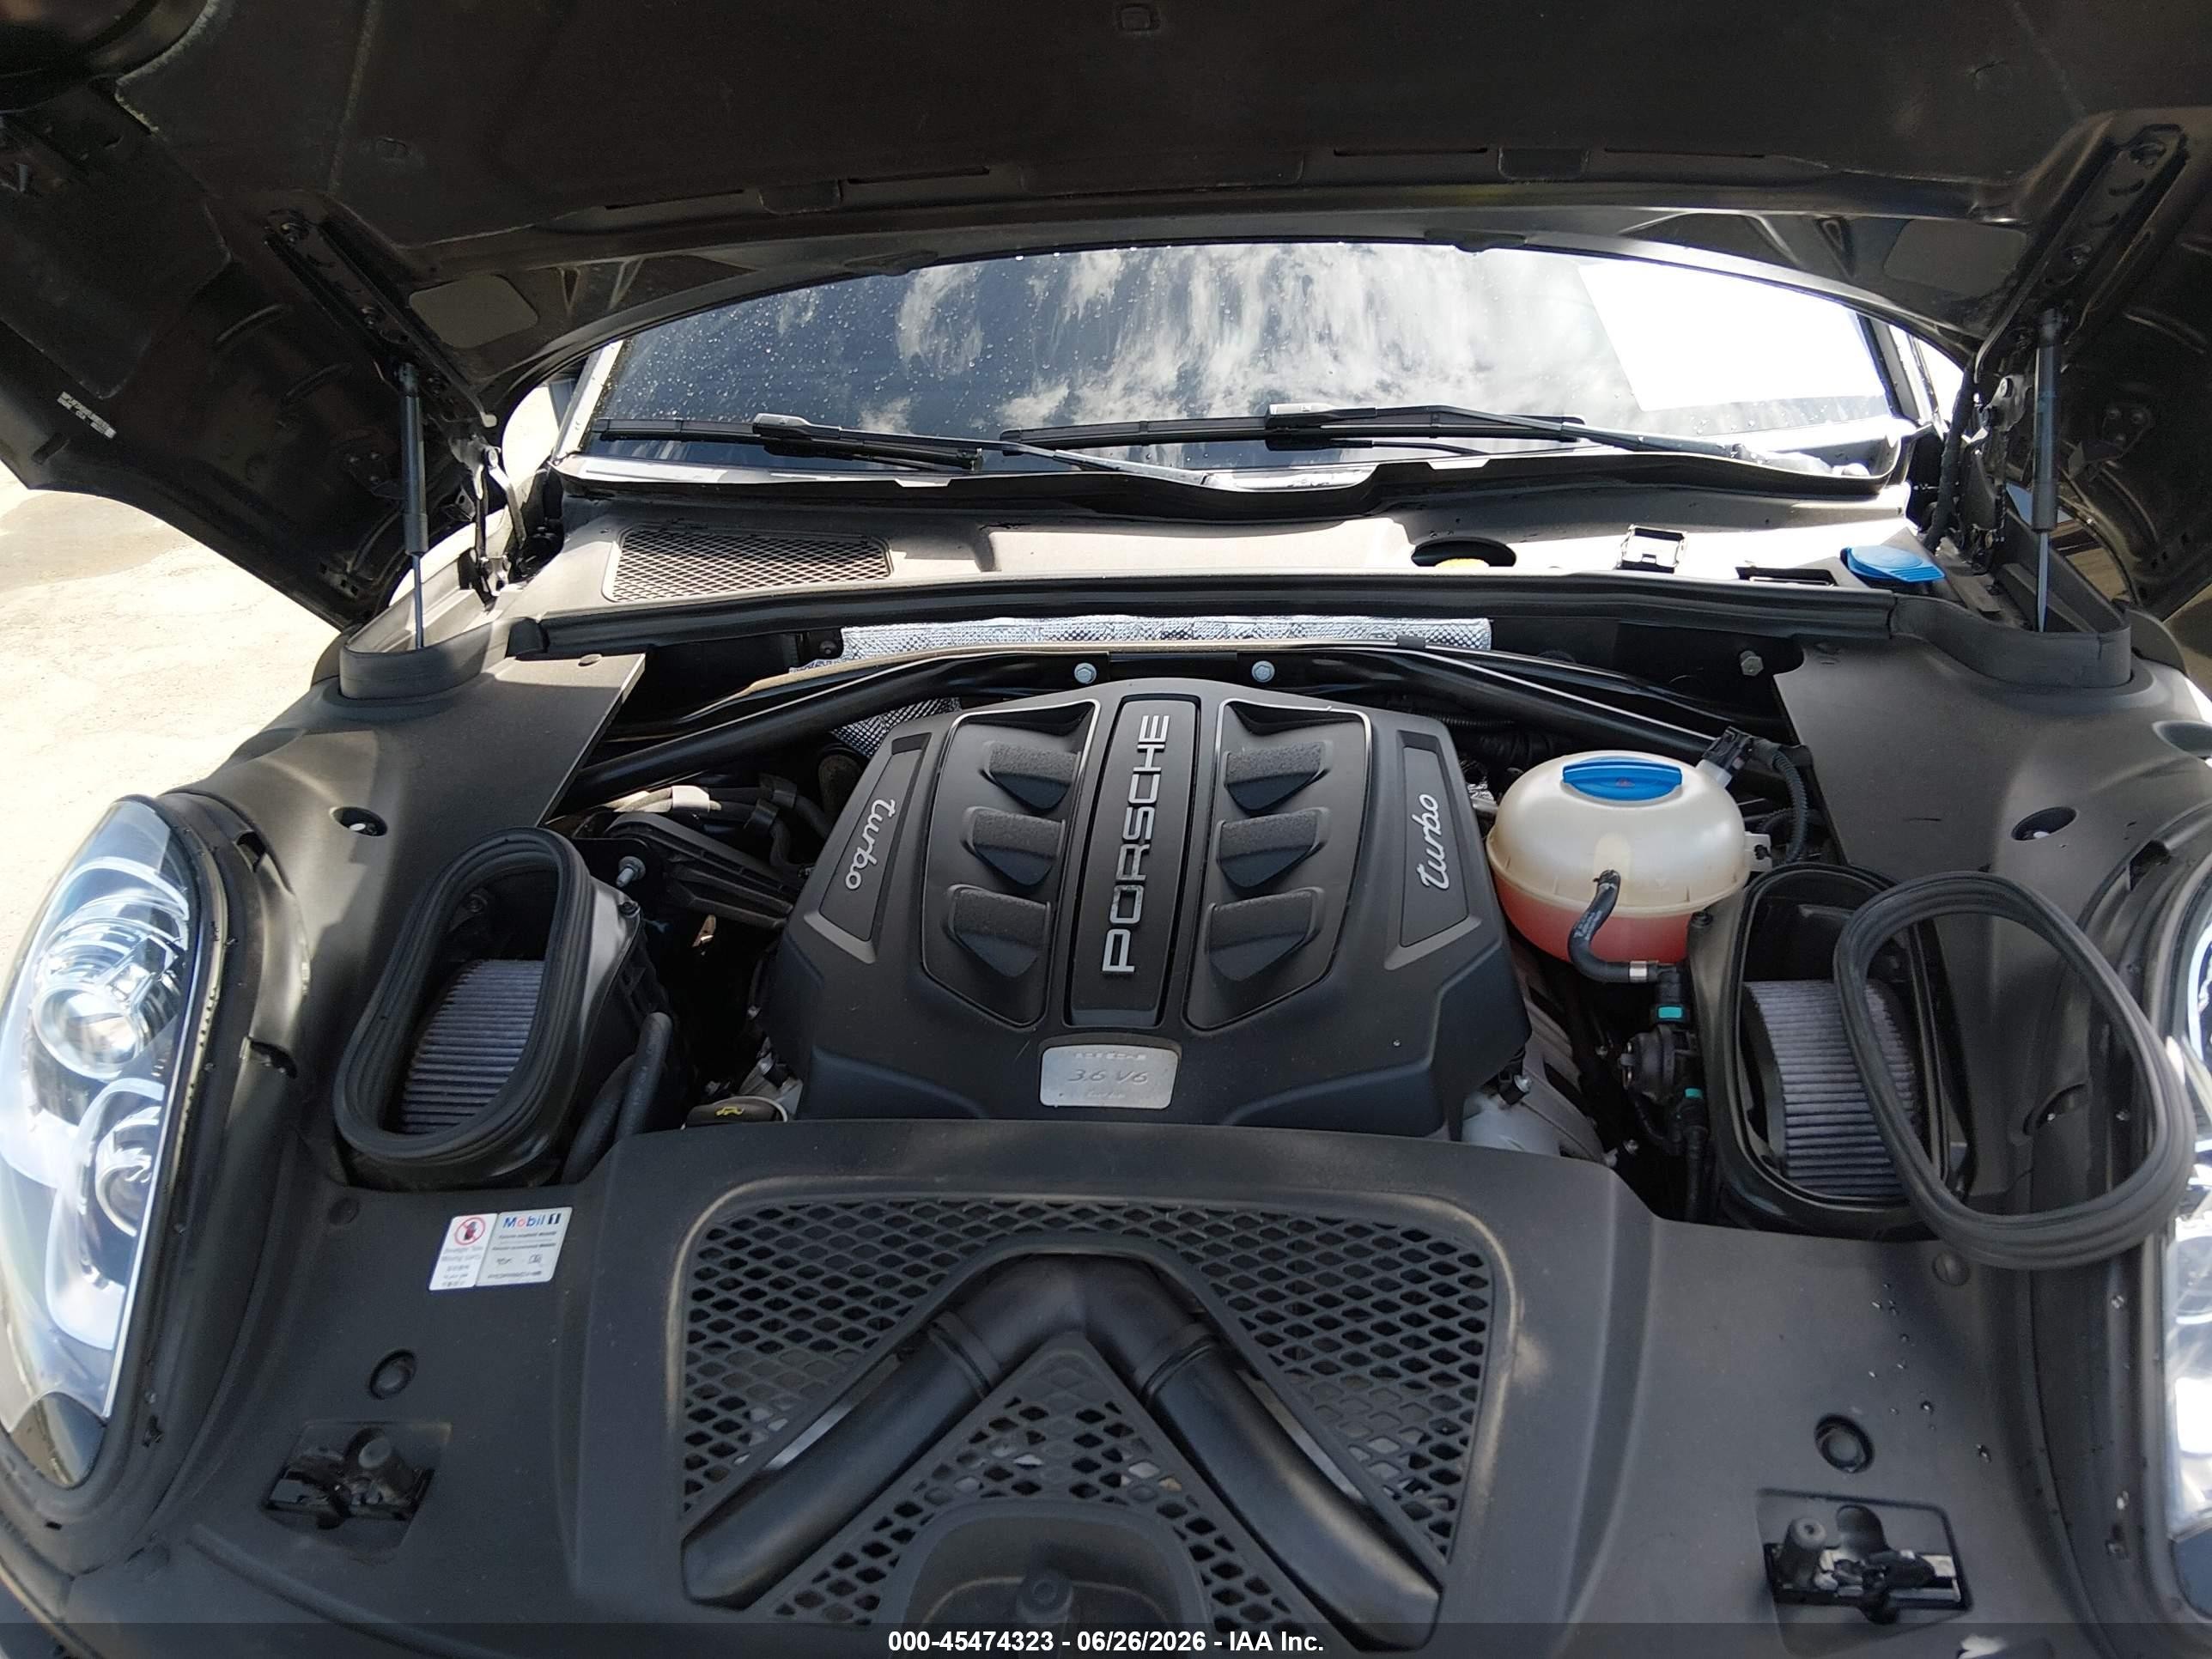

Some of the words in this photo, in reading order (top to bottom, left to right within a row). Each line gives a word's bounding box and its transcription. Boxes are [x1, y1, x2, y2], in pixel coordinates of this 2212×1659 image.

[845, 799, 896, 890] turbo
[1101, 713, 1170, 975] PORSCHE
[1411, 793, 1449, 890] turbo
[1067, 1068, 1107, 1084] 3.6
[1115, 1069, 1148, 1085] V6
[502, 1214, 546, 1229] Mobil
[548, 1212, 562, 1225] 1
